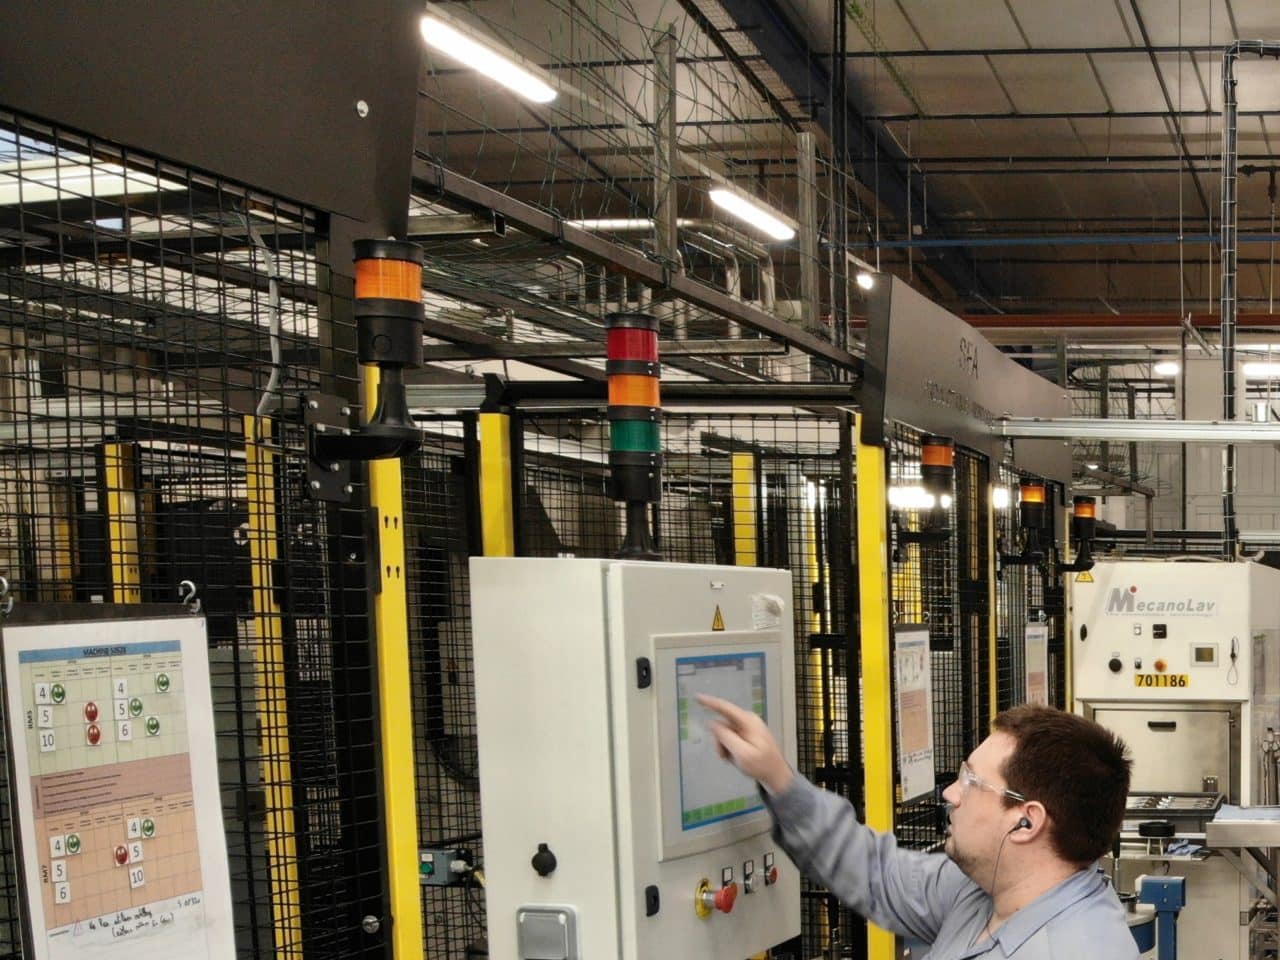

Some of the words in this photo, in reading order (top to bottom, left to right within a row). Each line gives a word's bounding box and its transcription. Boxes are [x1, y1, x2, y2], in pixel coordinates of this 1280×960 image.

[1107, 586, 1215, 613] MecanoLav
[1137, 675, 1186, 687] 701186
[42, 734, 54, 747] 10
[132, 870, 144, 884] 10
